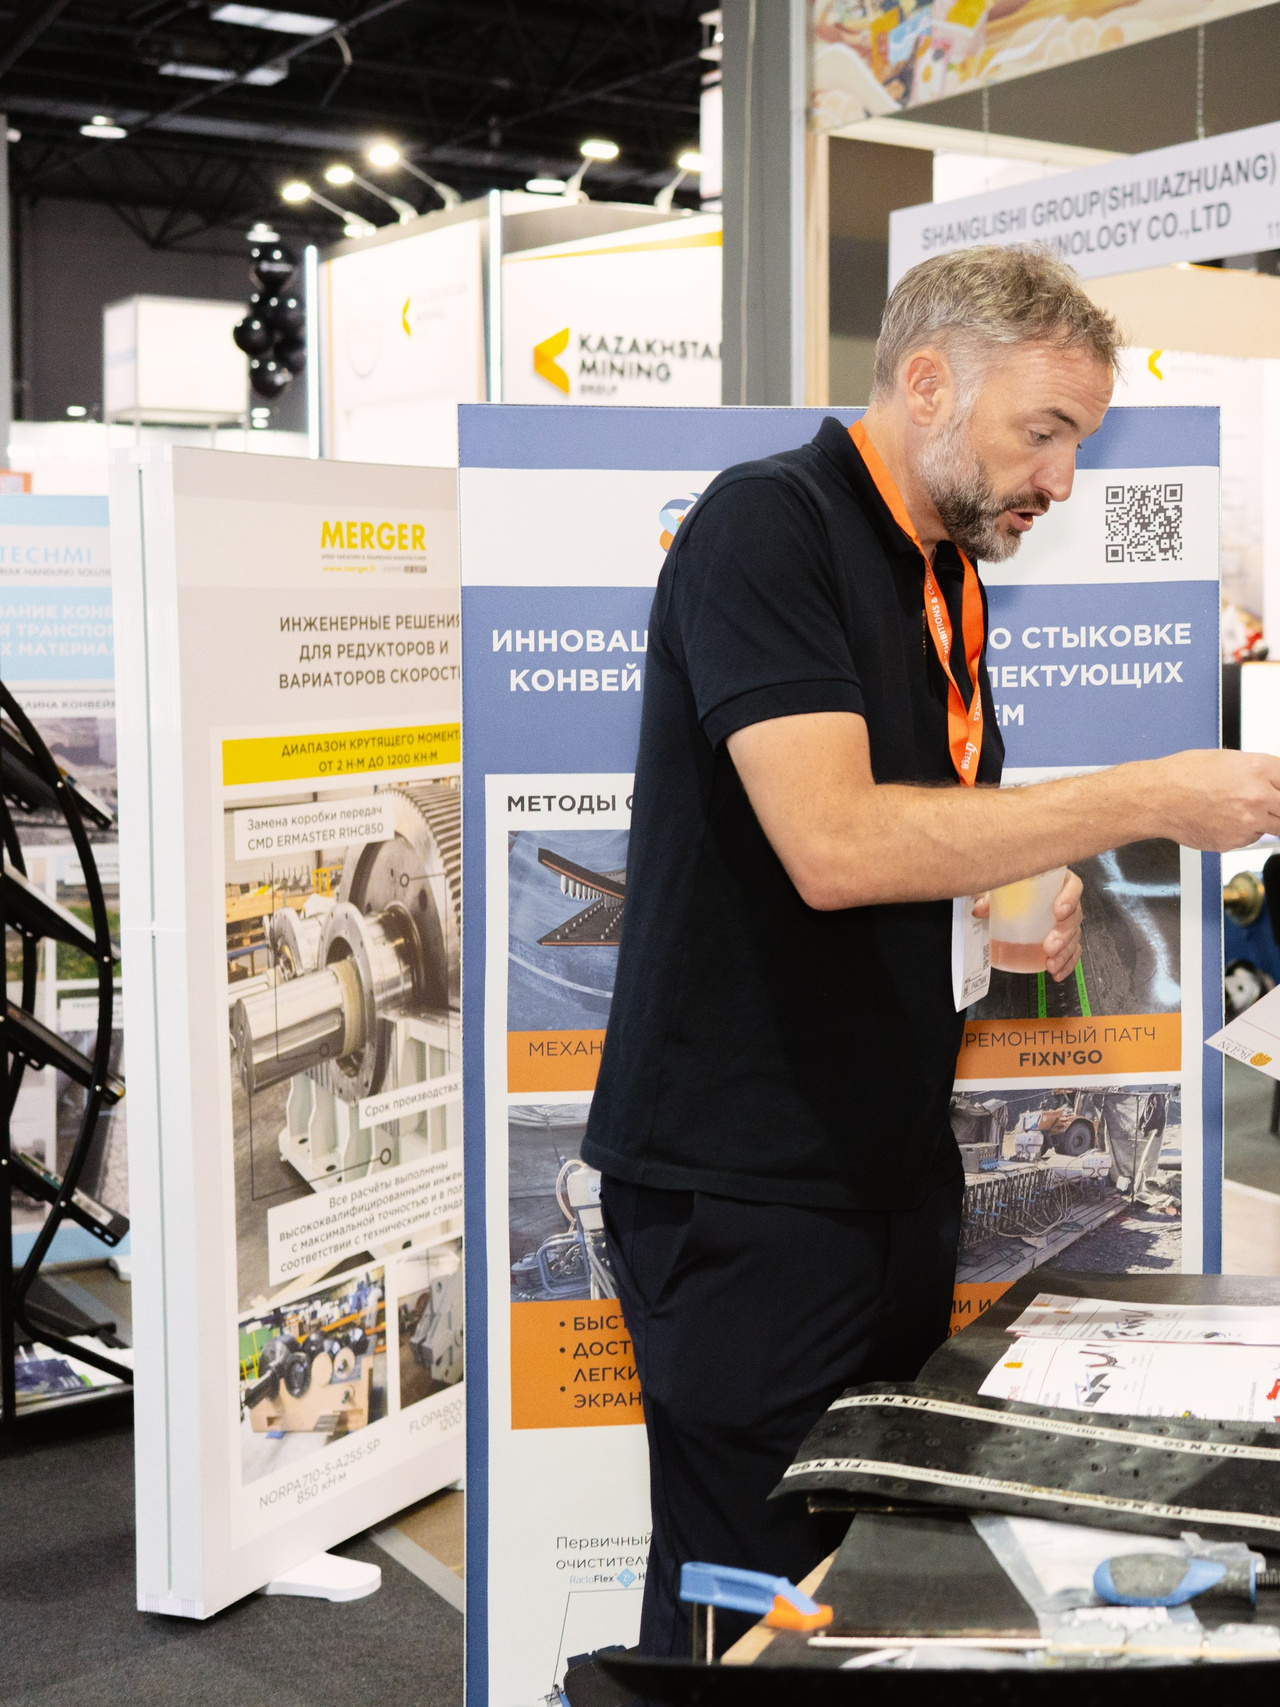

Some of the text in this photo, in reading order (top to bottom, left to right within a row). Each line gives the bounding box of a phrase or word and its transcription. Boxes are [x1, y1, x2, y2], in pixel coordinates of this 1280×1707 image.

[921, 151, 1278, 251] SHANGLISHI GROUP(SHIJIAZHUANG)
[578, 333, 722, 361] KAZAKHSTA
[579, 358, 671, 383] MINING
[320, 520, 426, 551] MERGER
[280, 615, 391, 632] ИНЖЕНЕРНЫЕ
[1022, 623, 1192, 650] СТЫКОВКЕ
[300, 640, 449, 663] ДЛЯ РЕДУКТОРОВ И
[279, 666, 460, 689] ВАРИАТОРОВ СКОРОСТ
[510, 662, 642, 692] КОНВЕЙ
[281, 729, 460, 757] ДИАПАЗОН КРУТЯЩЕГО МОМЕНТ
[319, 761, 334, 773] ОТ
[337, 759, 343, 770] 2
[368, 756, 384, 769] ДО
[388, 753, 410, 766] 1200
[507, 795, 617, 814] МЕТОДЫ
[247, 806, 383, 831] Замена коробки передач
[248, 822, 384, 851] CMD ERMASTER R1HC850
[529, 1040, 603, 1057] МЕХАН
[965, 1026, 1156, 1048] РЕМОНТНЫЙ ПАТЧ
[1217, 1039, 1251, 1061] BGDN
[365, 1102, 390, 1117] Срок
[329, 1161, 449, 1209] Все расчёты выполнены
[279, 1182, 431, 1242] высококвалифицированными
[292, 1243, 298, 1253] с
[300, 1214, 375, 1250] максимальной
[378, 1196, 429, 1219] точностью
[431, 1192, 437, 1201] и
[280, 1239, 352, 1272] соответствии
[354, 1234, 360, 1244] с
[363, 1211, 431, 1243] техническими
[573, 1341, 631, 1359] ДОСТ
[858, 1396, 879, 1404] GO
[1006, 1415, 1074, 1433] INNOVATION
[790, 1463, 810, 1473] GO
[297, 1484, 318, 1505] 850
[556, 1532, 652, 1550] Первичный
